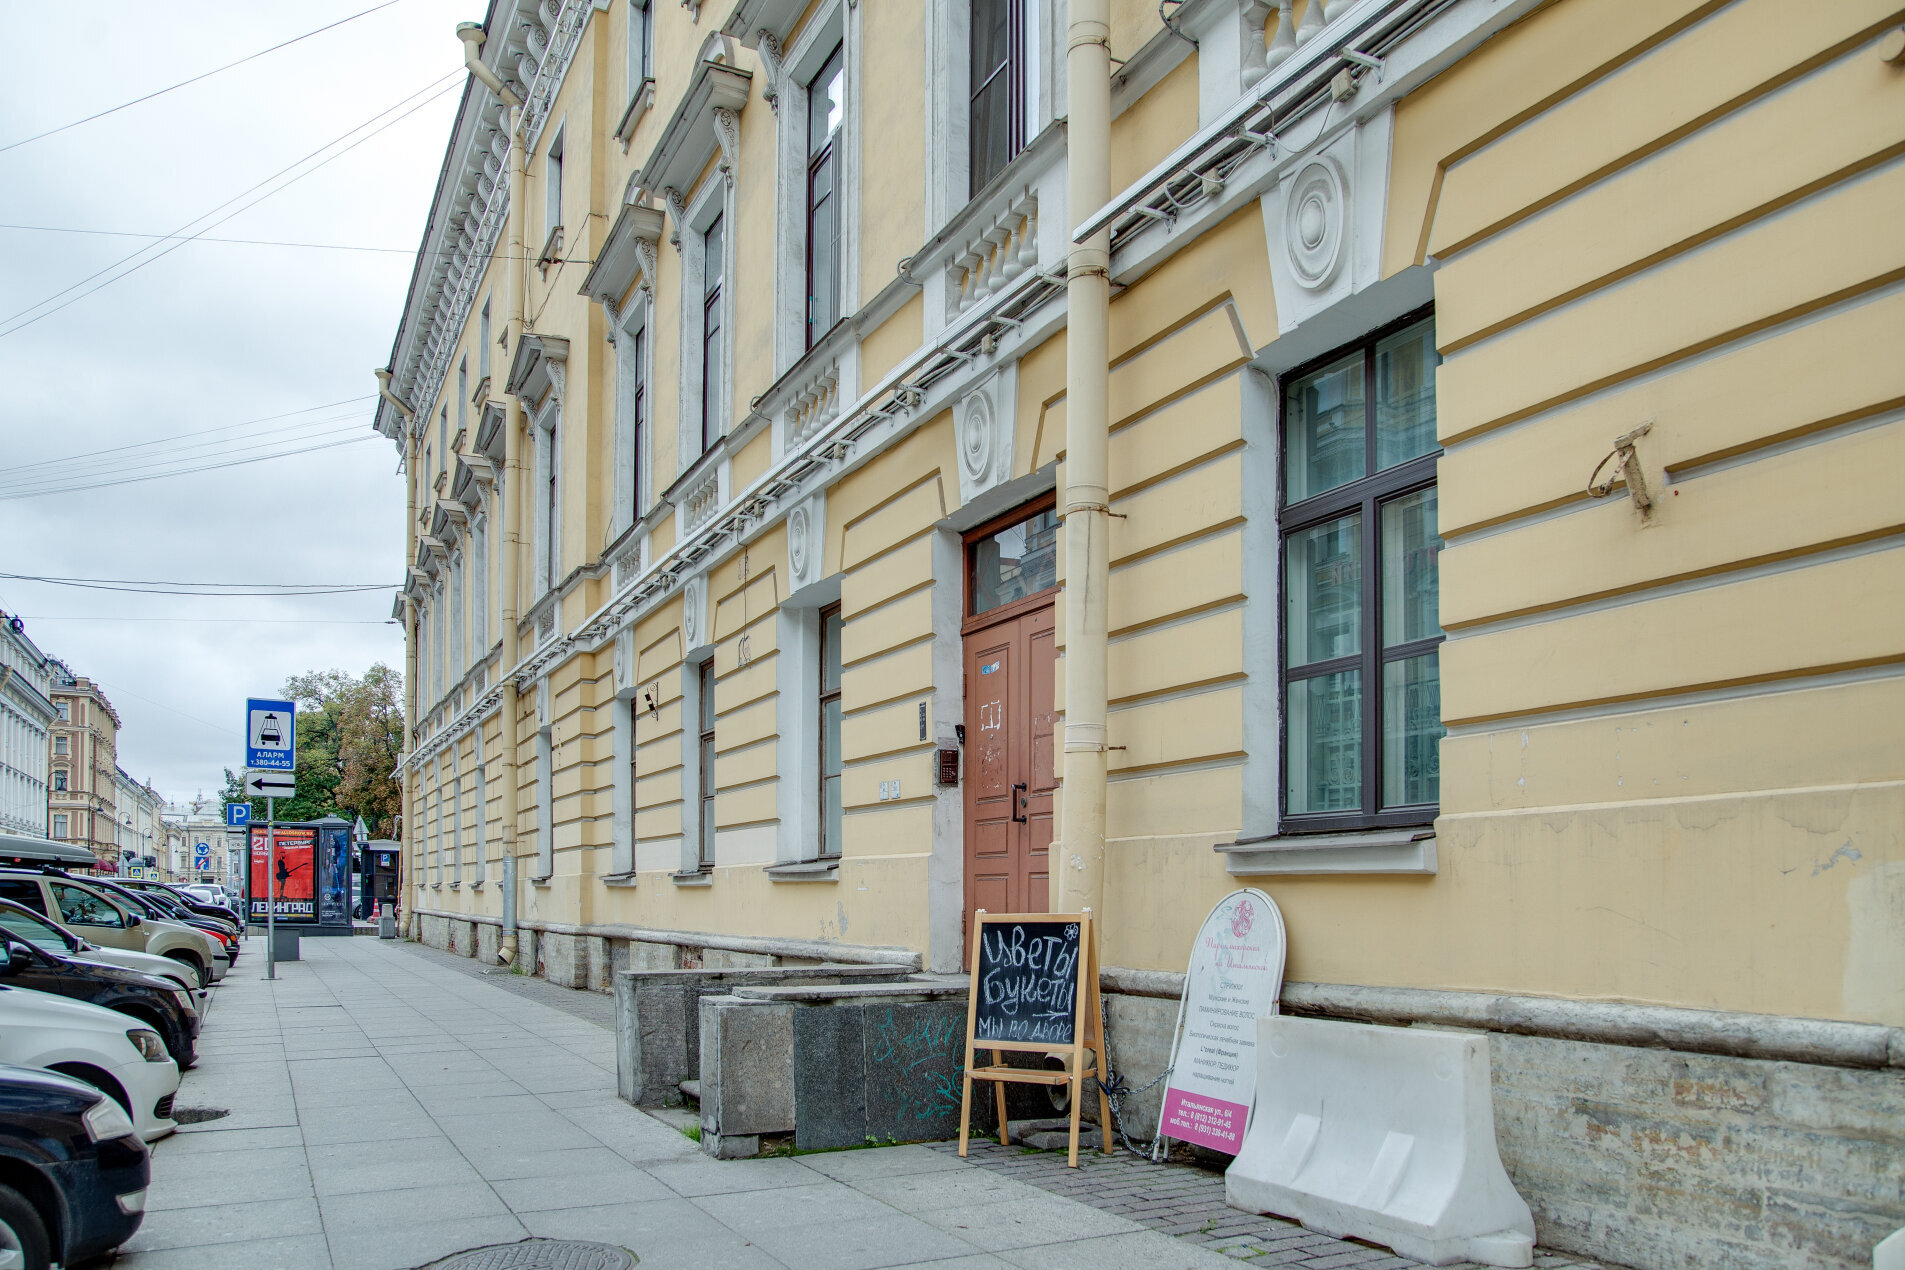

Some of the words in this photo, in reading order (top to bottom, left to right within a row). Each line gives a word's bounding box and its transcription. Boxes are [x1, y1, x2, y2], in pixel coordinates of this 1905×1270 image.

[256, 751, 285, 759] АЛАРМ
[233, 805, 247, 824] P
[1219, 982, 1244, 991] СТРИЖКИ
[1198, 1005, 1239, 1018] ЛАМИНИРОВАНИЕ
[1239, 1010, 1256, 1020] ВОЛОС
[1180, 1098, 1214, 1114] Итальянская
